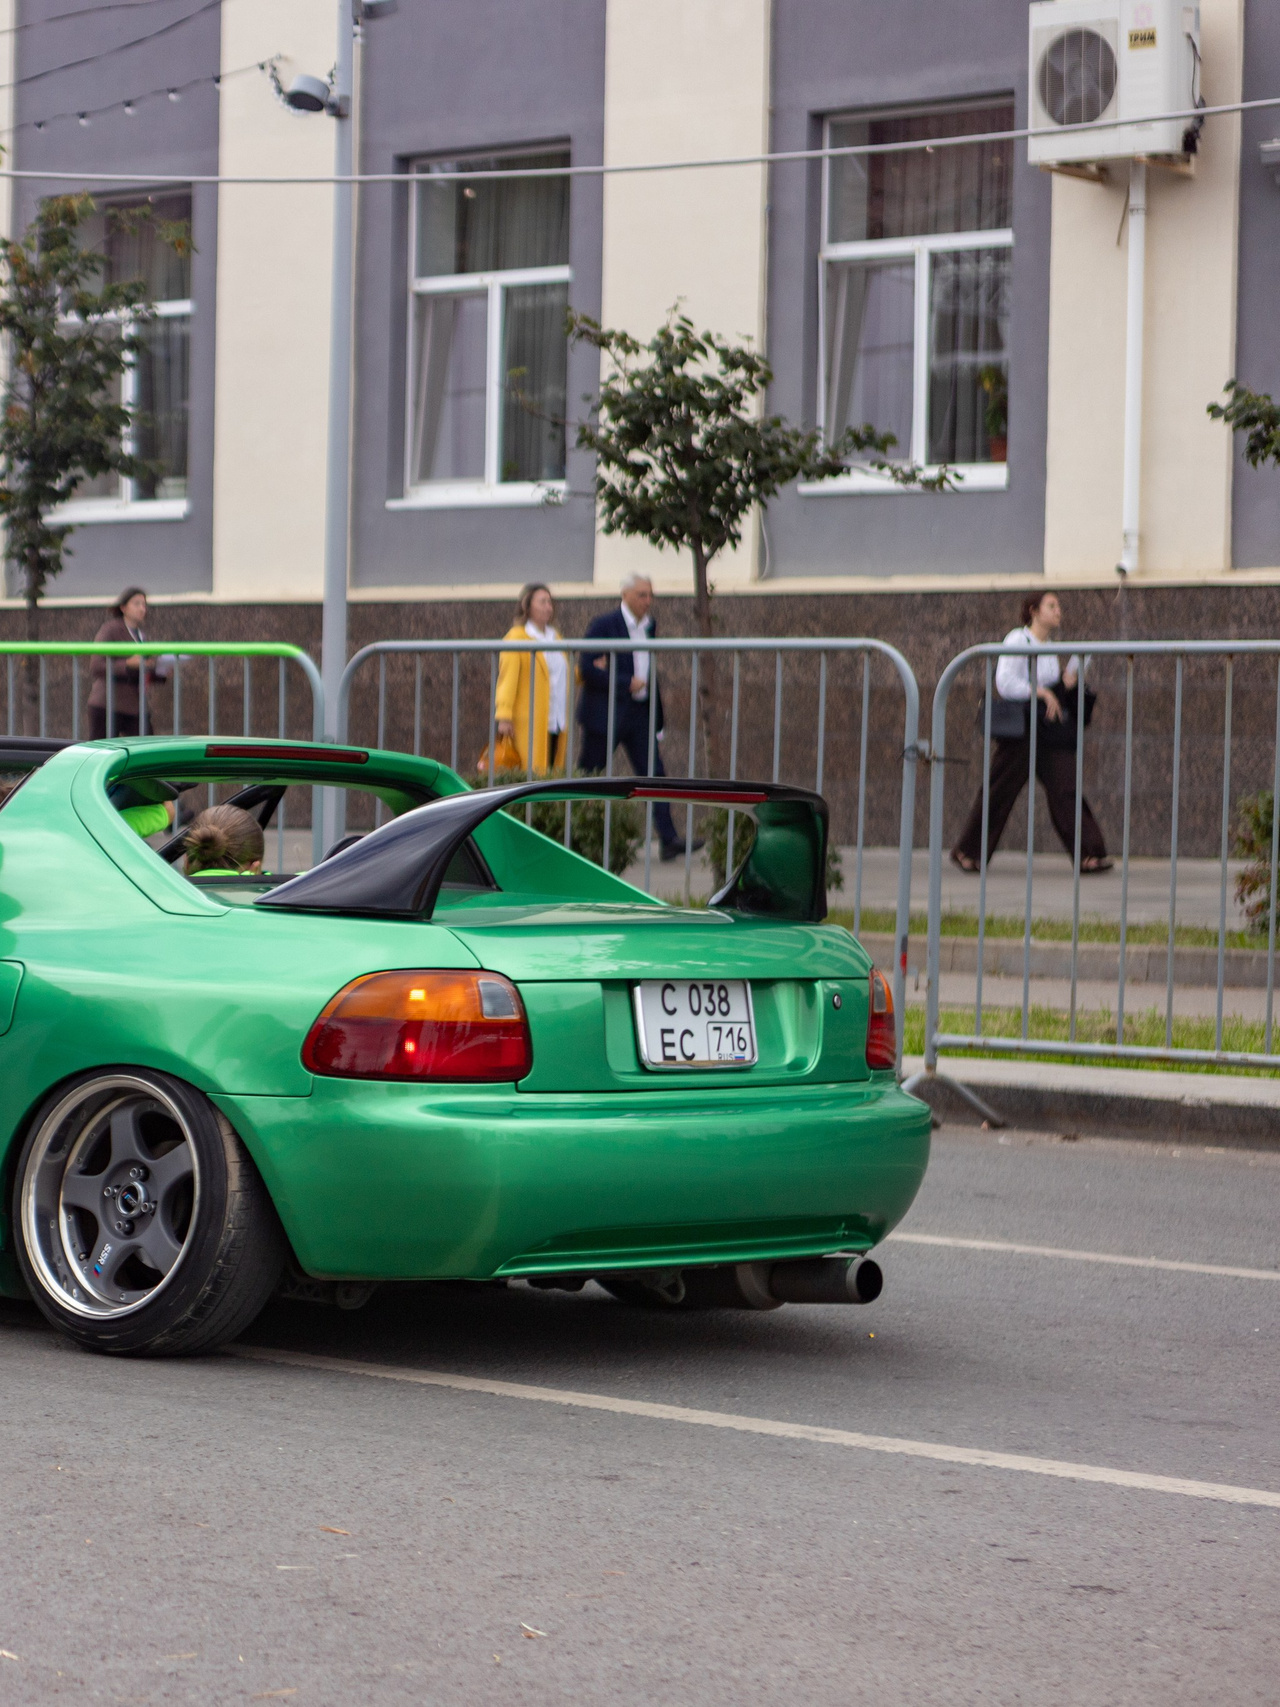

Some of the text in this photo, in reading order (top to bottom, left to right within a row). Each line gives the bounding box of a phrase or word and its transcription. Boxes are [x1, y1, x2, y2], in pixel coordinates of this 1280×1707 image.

[689, 983, 730, 1016] 038
[713, 1026, 747, 1052] 716
[718, 1053, 733, 1061] RUS
[97, 1243, 112, 1265] SSR
